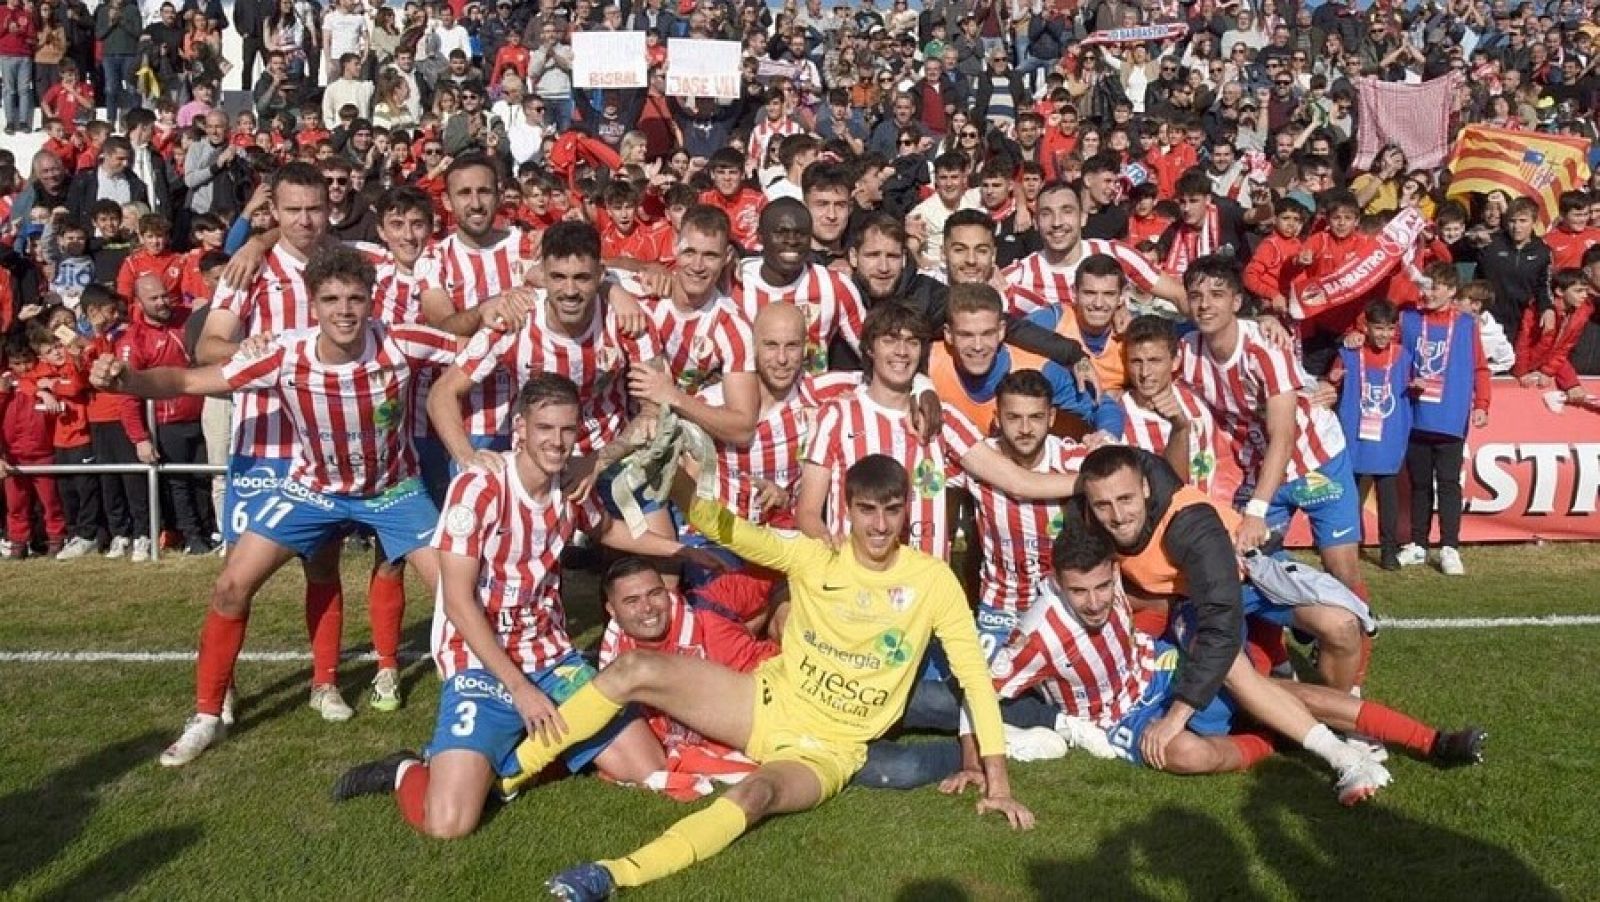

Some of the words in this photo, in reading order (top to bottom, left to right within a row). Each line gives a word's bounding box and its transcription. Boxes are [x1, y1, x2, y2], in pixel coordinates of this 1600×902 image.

[1323, 250, 1386, 294] BARBASTRO
[1455, 442, 1600, 514] ST
[232, 501, 248, 533] 6
[451, 700, 477, 736] 3
